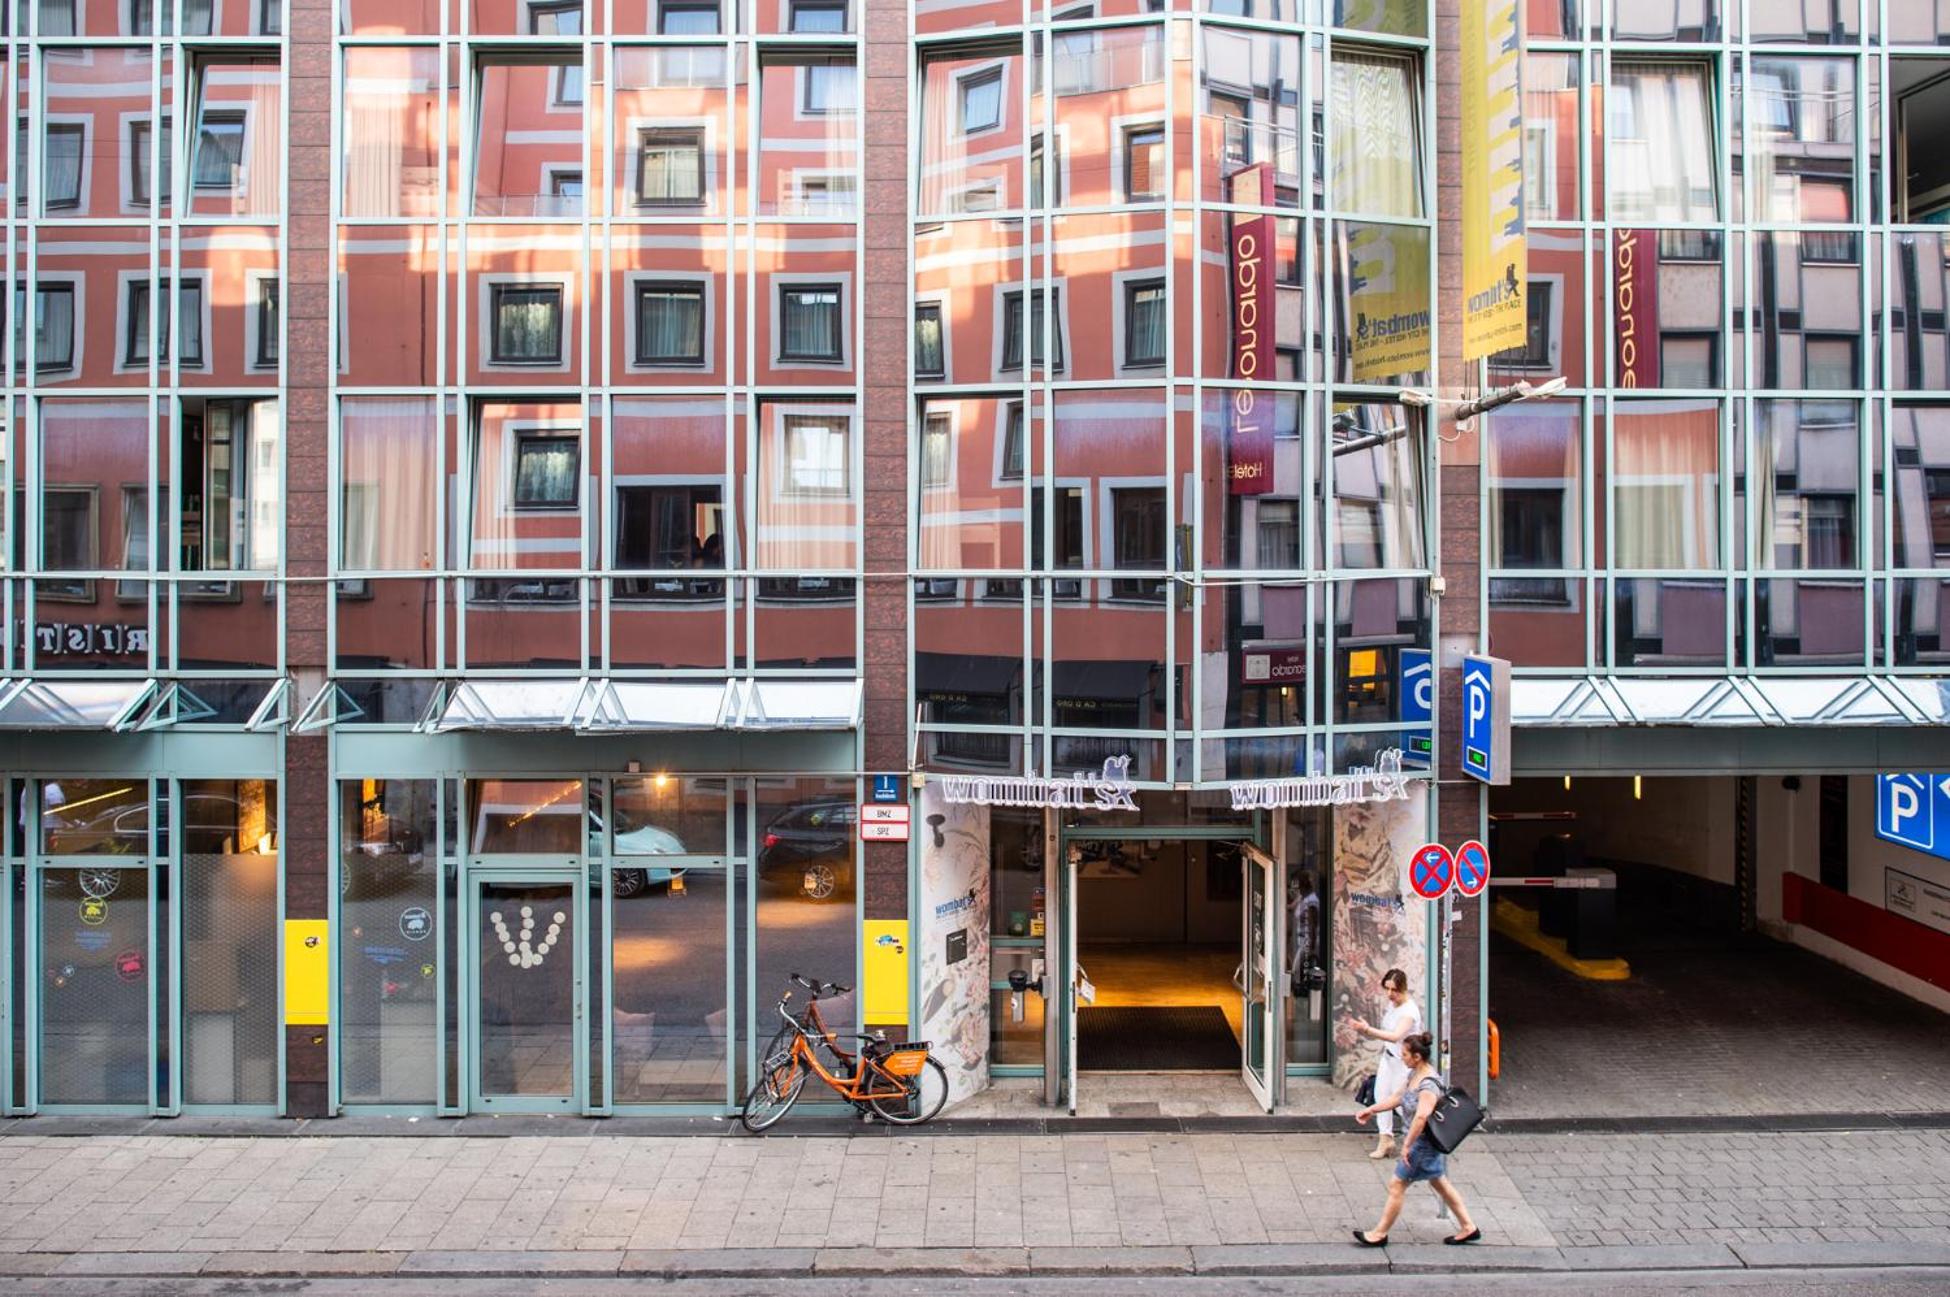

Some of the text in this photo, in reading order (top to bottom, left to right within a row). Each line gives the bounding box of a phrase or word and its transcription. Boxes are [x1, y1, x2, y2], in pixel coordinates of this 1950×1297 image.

[1469, 684, 1486, 739] P
[942, 767, 1128, 812] wombat's
[1231, 764, 1408, 811] wombat's
[1891, 782, 1919, 833] P
